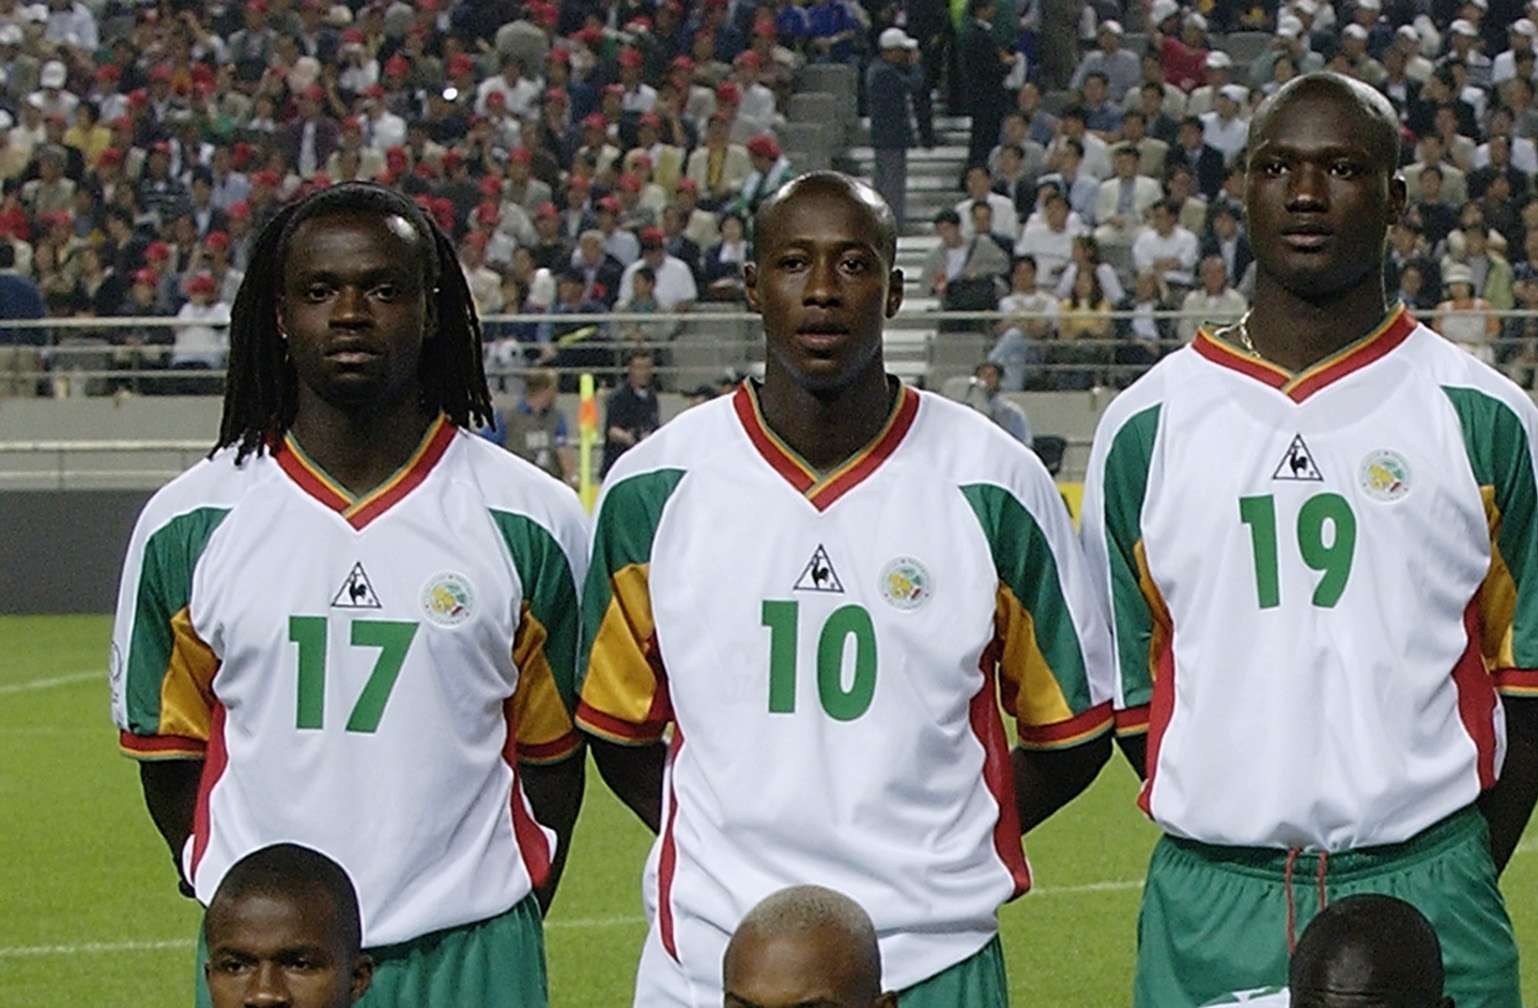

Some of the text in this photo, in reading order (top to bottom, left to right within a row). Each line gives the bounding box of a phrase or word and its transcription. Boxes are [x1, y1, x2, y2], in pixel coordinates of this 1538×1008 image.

[1239, 492, 1357, 609] 19
[287, 615, 419, 733] 17
[760, 600, 878, 721] 10
